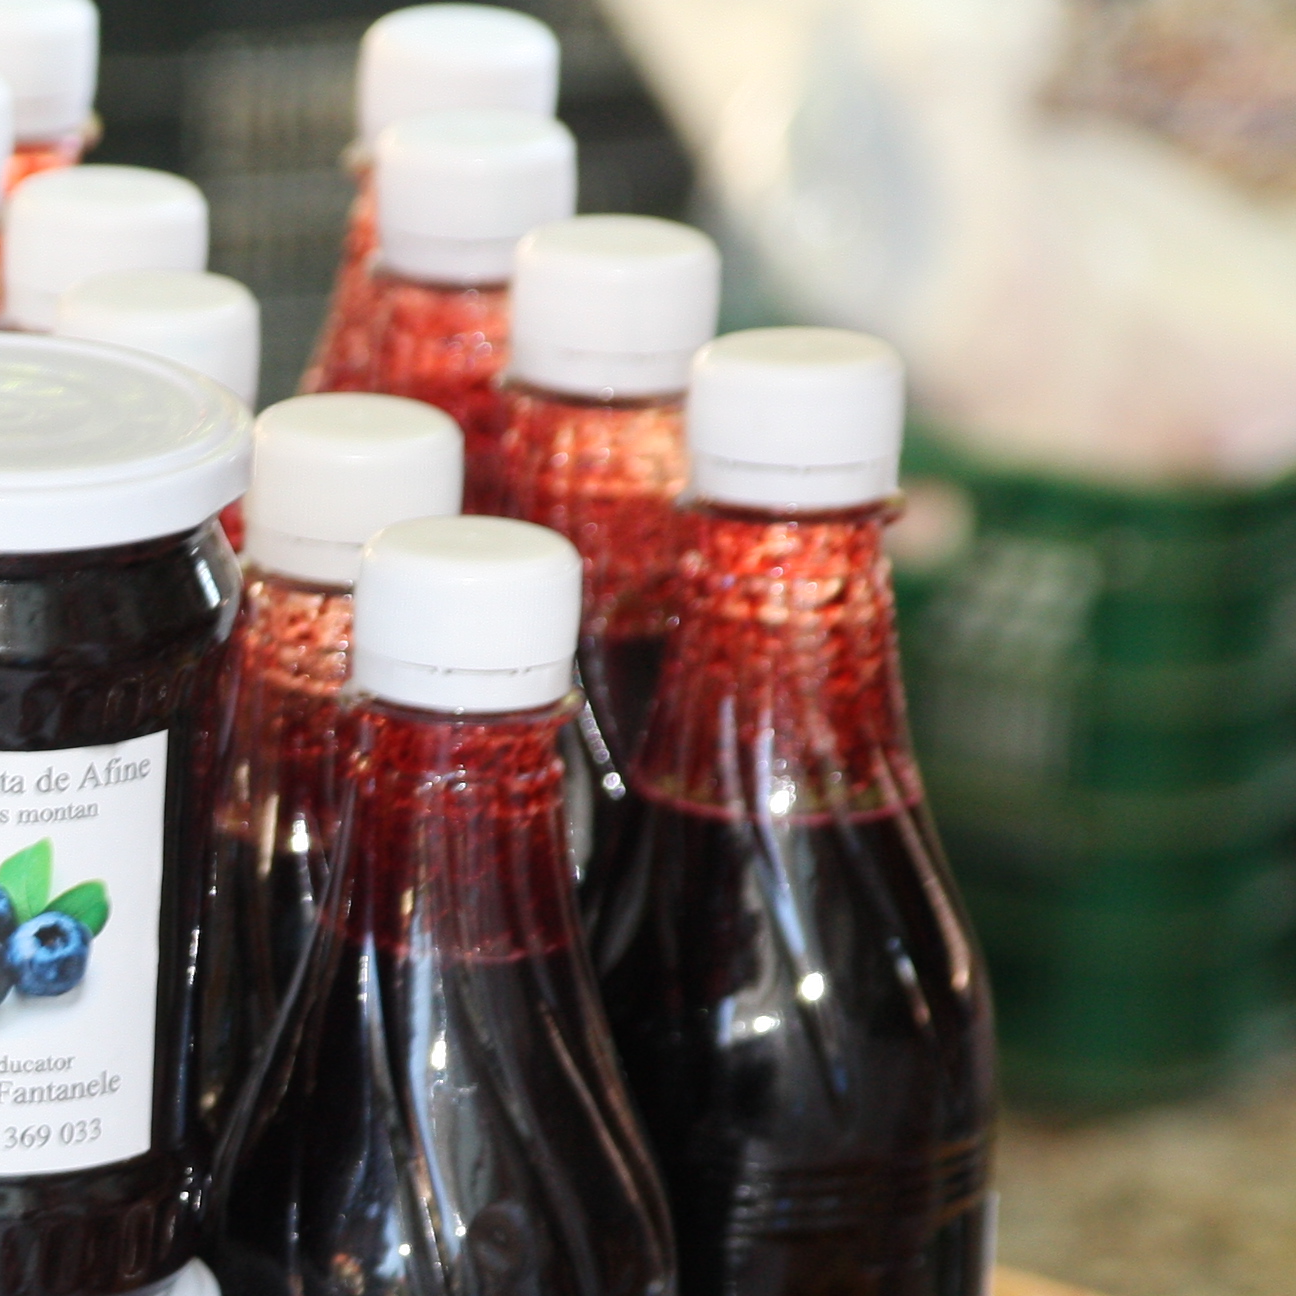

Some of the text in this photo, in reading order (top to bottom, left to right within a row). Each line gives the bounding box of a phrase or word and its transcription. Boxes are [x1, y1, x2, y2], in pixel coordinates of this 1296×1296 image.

[35, 765, 71, 793] de
[77, 755, 152, 790] Afine
[16, 801, 99, 824] montan
[4, 1123, 51, 1149] 369
[59, 1117, 103, 1145] 033
